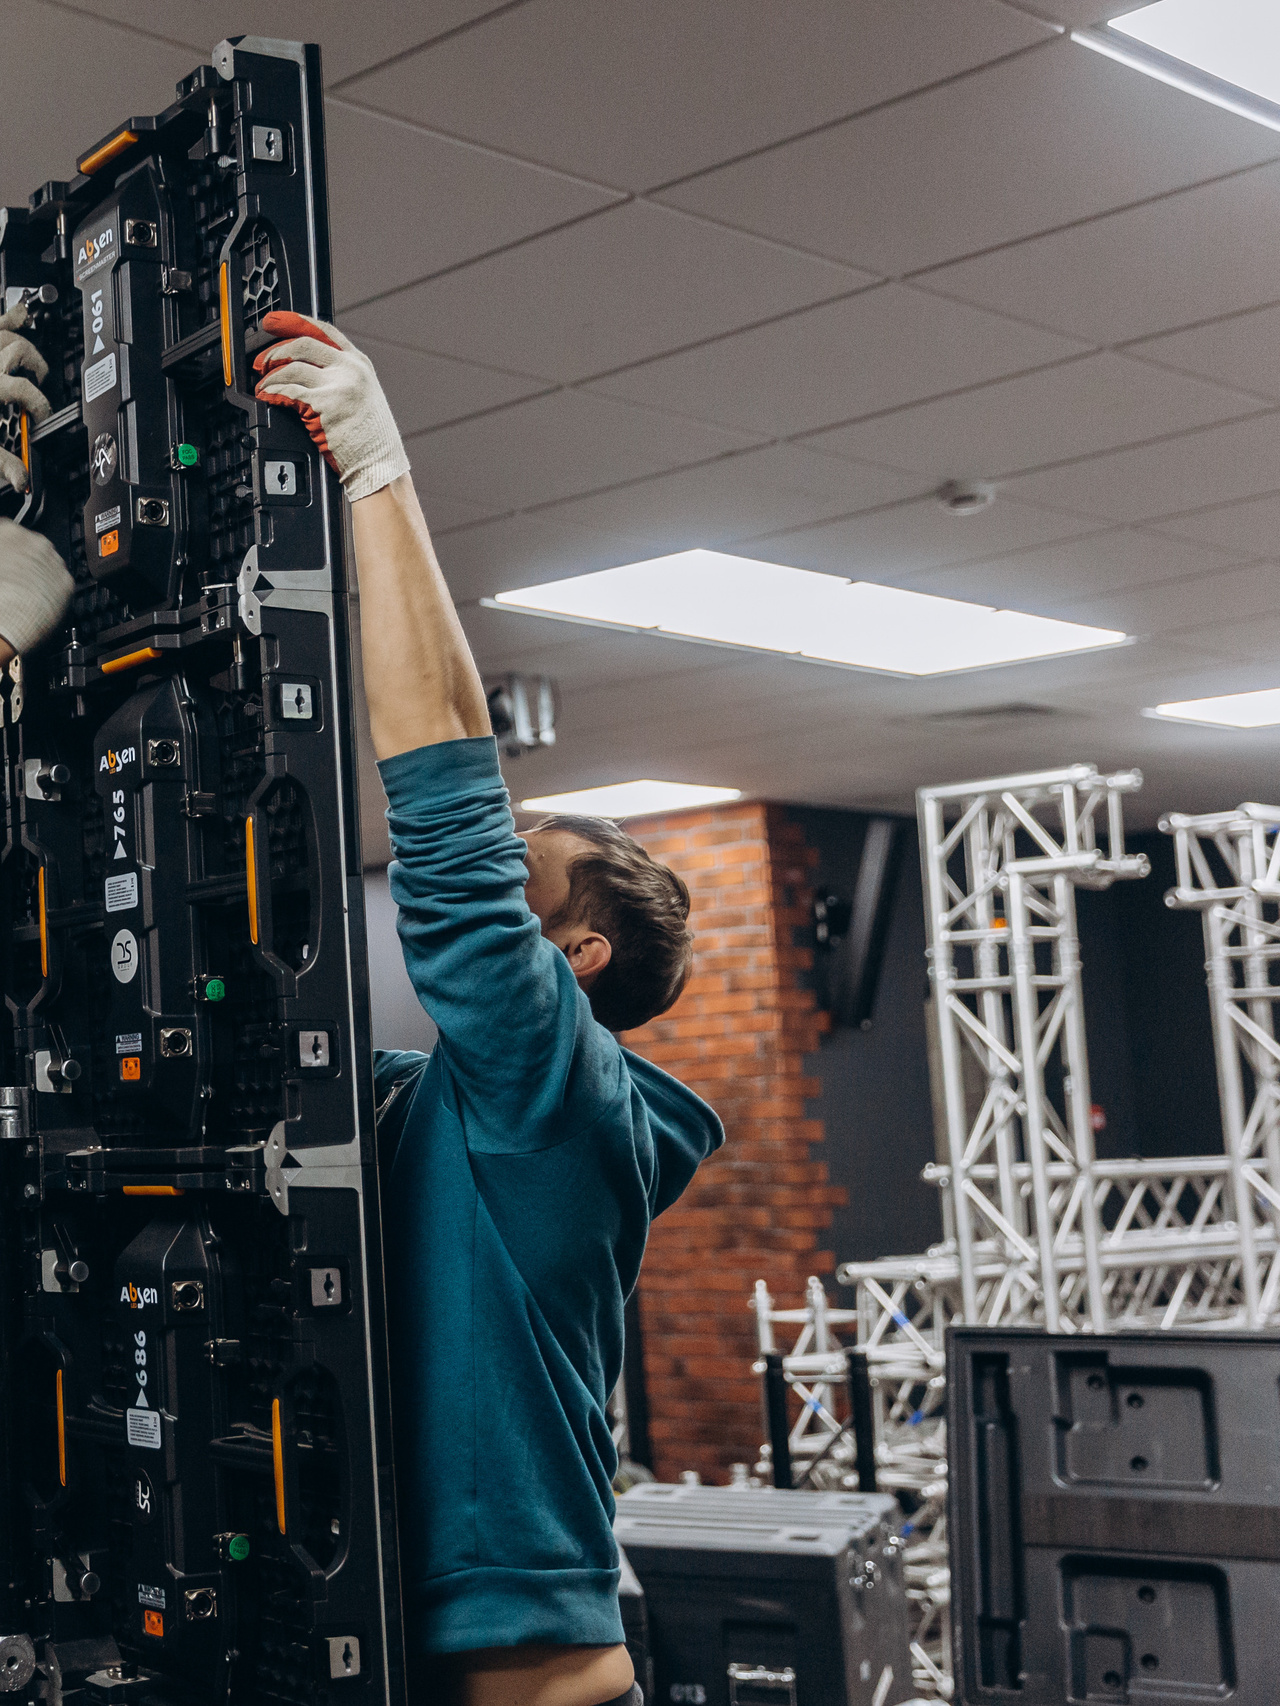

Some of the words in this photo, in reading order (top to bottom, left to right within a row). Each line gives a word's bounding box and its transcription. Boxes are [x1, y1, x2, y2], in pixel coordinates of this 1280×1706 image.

[78, 228, 113, 264] Absen
[79, 250, 116, 280] SCREENMASTER
[91, 289, 103, 334] 061
[99, 746, 136, 773] Absen
[112, 789, 126, 840] 765
[120, 1282, 158, 1309] Absen
[134, 1330, 147, 1387] 686
